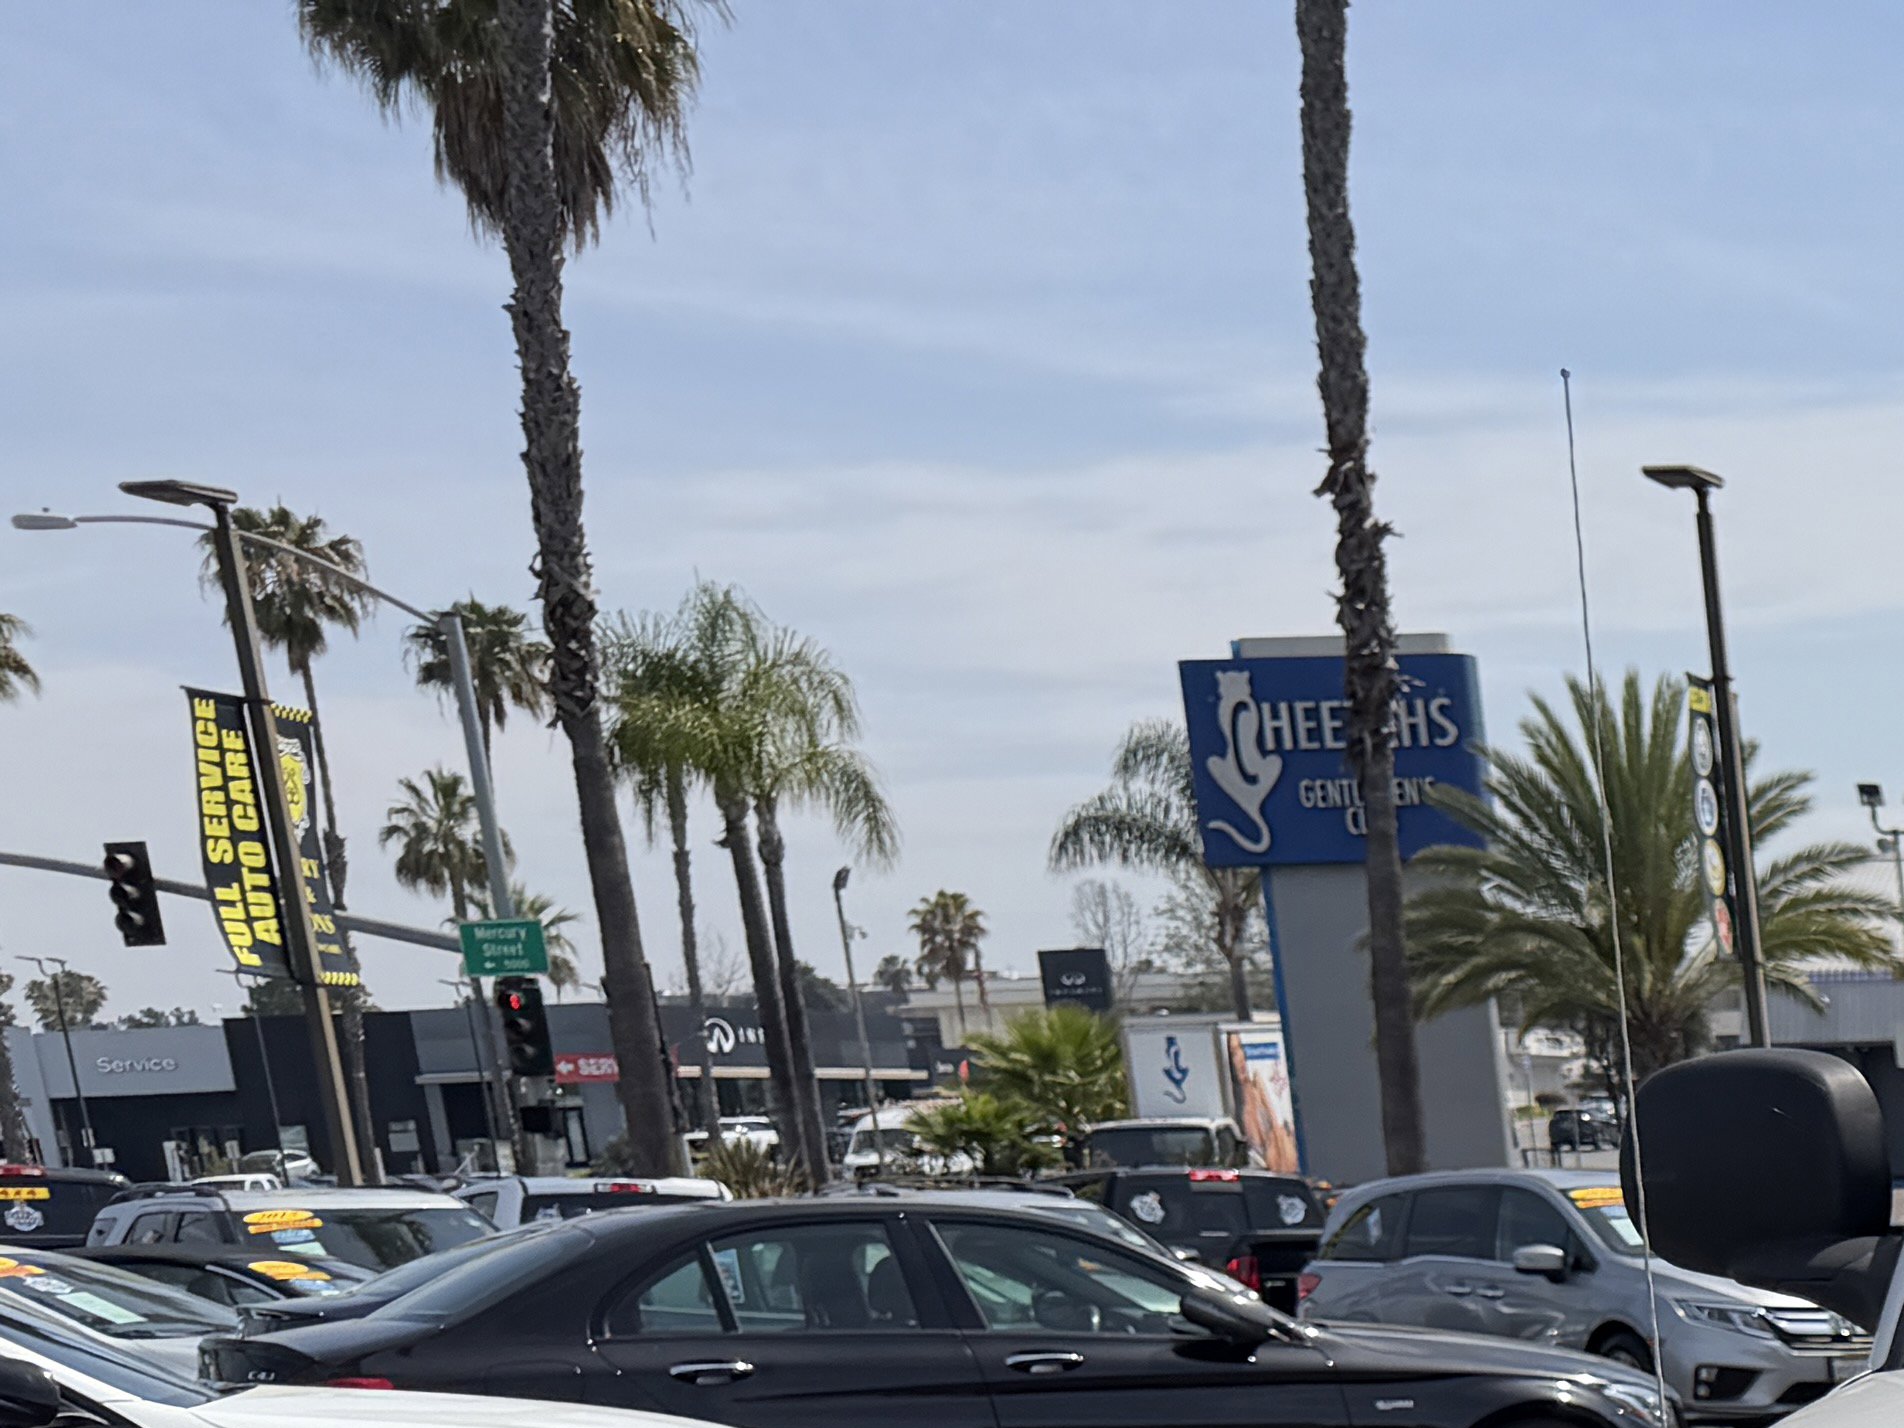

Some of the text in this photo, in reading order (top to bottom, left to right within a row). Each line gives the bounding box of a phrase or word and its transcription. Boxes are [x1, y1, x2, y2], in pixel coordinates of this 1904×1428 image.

[193, 697, 264, 968] FULL SERVICE
[221, 729, 283, 946] AUTO CARE
[482, 942, 523, 957] Street
[96, 1056, 178, 1073] Service
